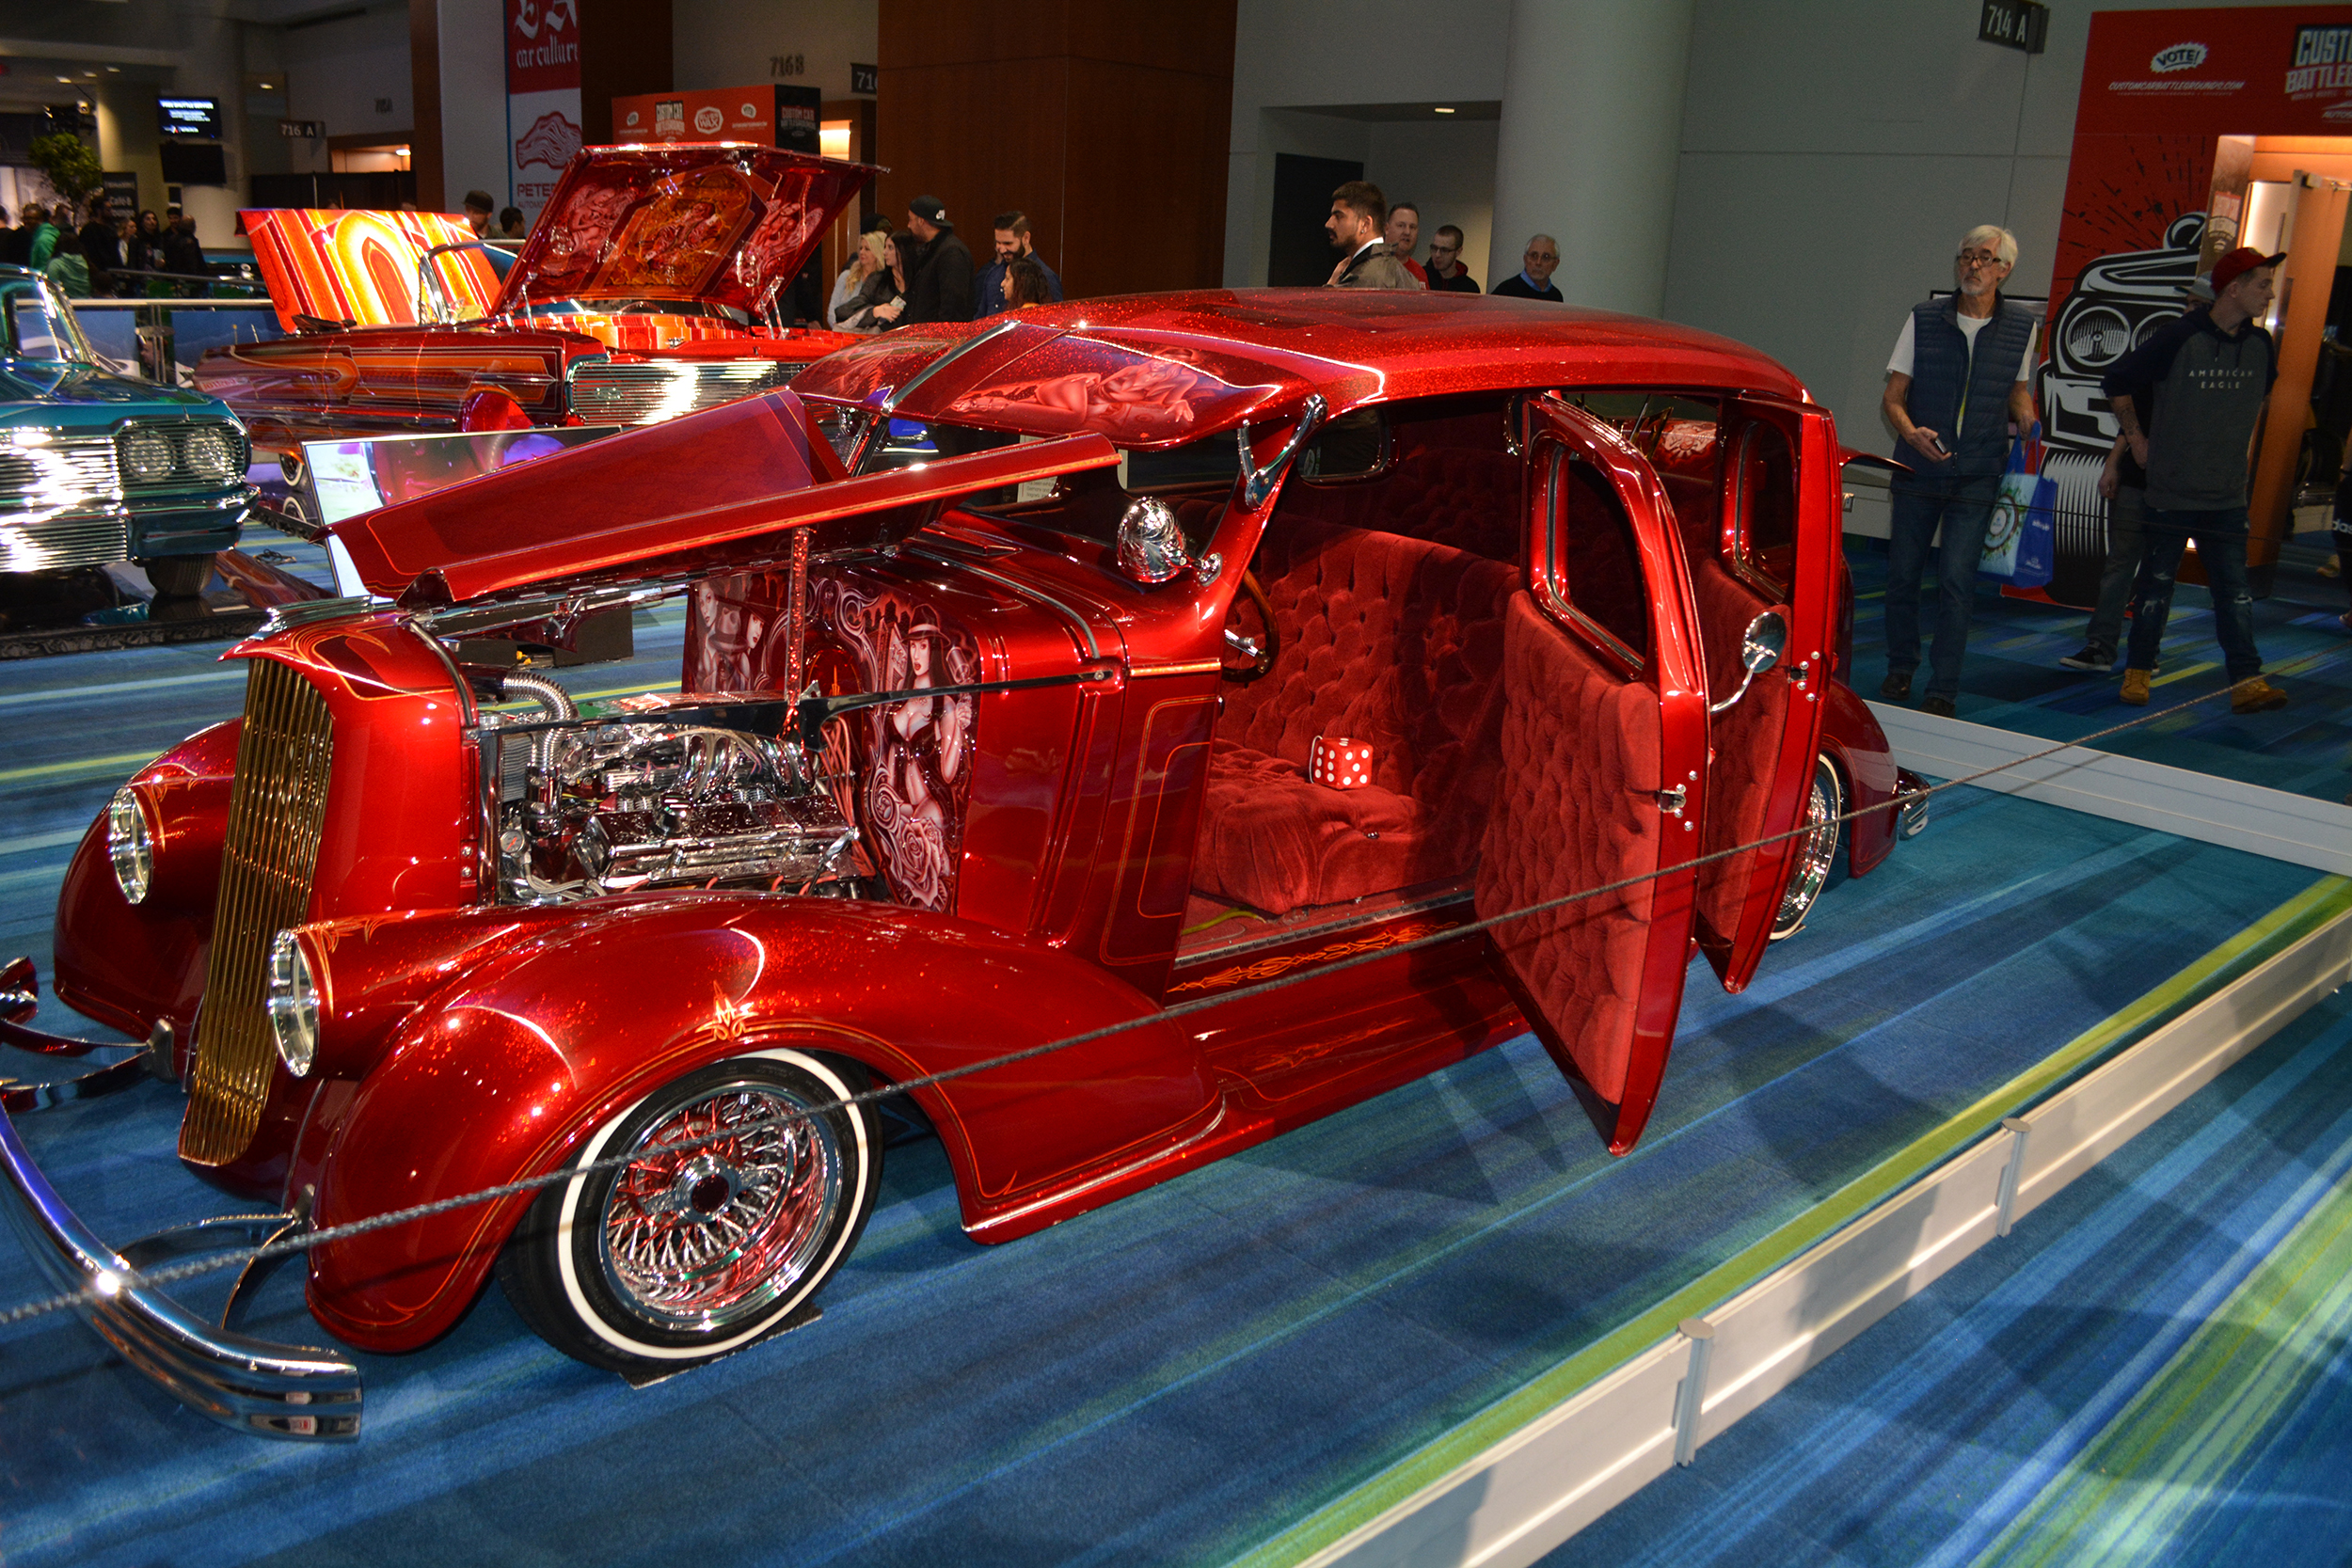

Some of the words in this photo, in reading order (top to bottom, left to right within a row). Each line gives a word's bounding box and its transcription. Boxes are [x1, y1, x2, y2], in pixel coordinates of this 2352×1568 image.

[1986, 4, 2011, 39] 714
[2015, 14, 2026, 43] A
[516, 48, 534, 69] car
[2156, 49, 2201, 66] VOTE!
[2107, 80, 2246, 91] CUSTOMCARBATTLEGROUNDS.COM
[698, 119, 719, 128] WAX
[280, 123, 301, 137] 716
[306, 124, 314, 137] A
[2188, 368, 2253, 378] AMERICAN
[2201, 380, 2240, 389] EAGLE
